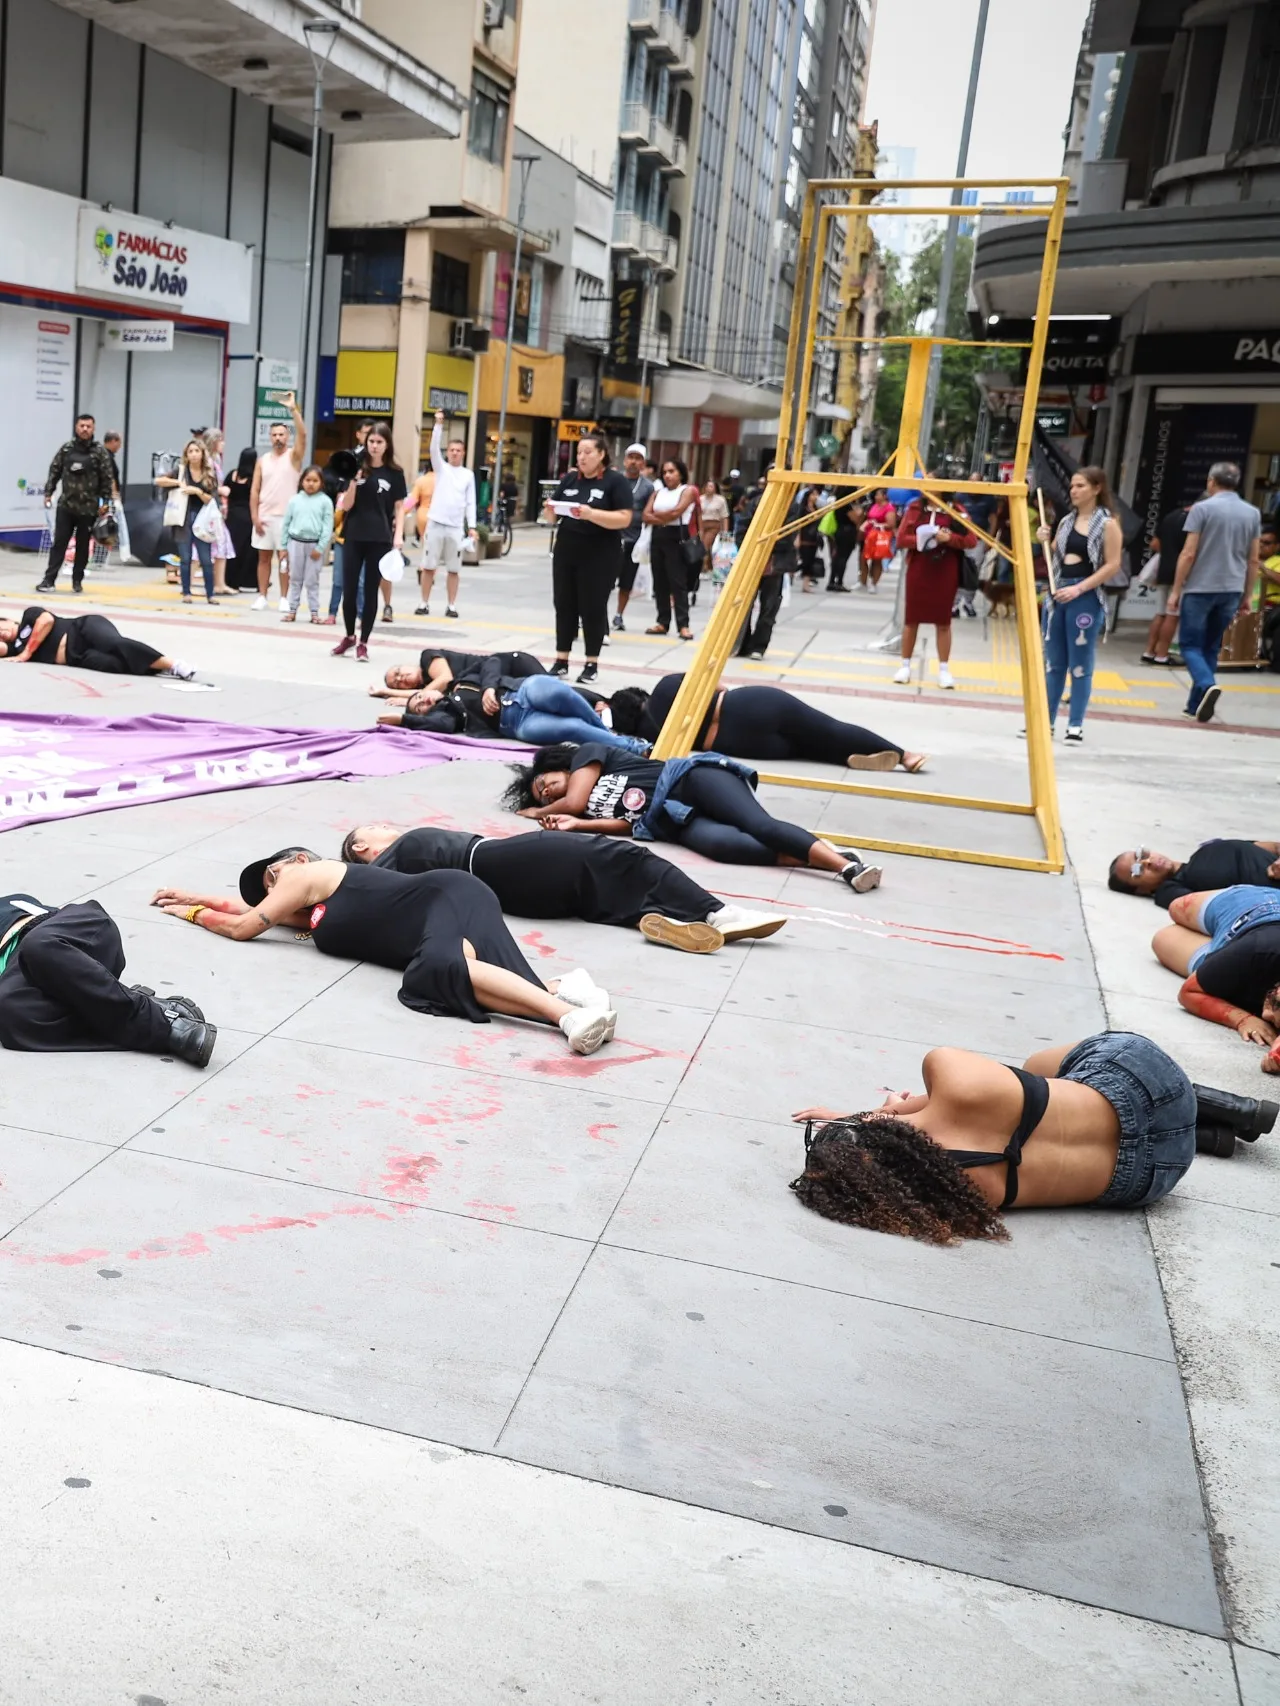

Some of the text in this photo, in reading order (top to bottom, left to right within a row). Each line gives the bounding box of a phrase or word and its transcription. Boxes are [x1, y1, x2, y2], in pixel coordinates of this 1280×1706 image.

[116, 230, 188, 264] FARMÁCIAS
[113, 255, 188, 297] São João
[122, 334, 167, 343] São João
[352, 398, 363, 410] DA
[365, 398, 390, 411] PRAIA
[1151, 419, 1172, 499] MASCULINOS
